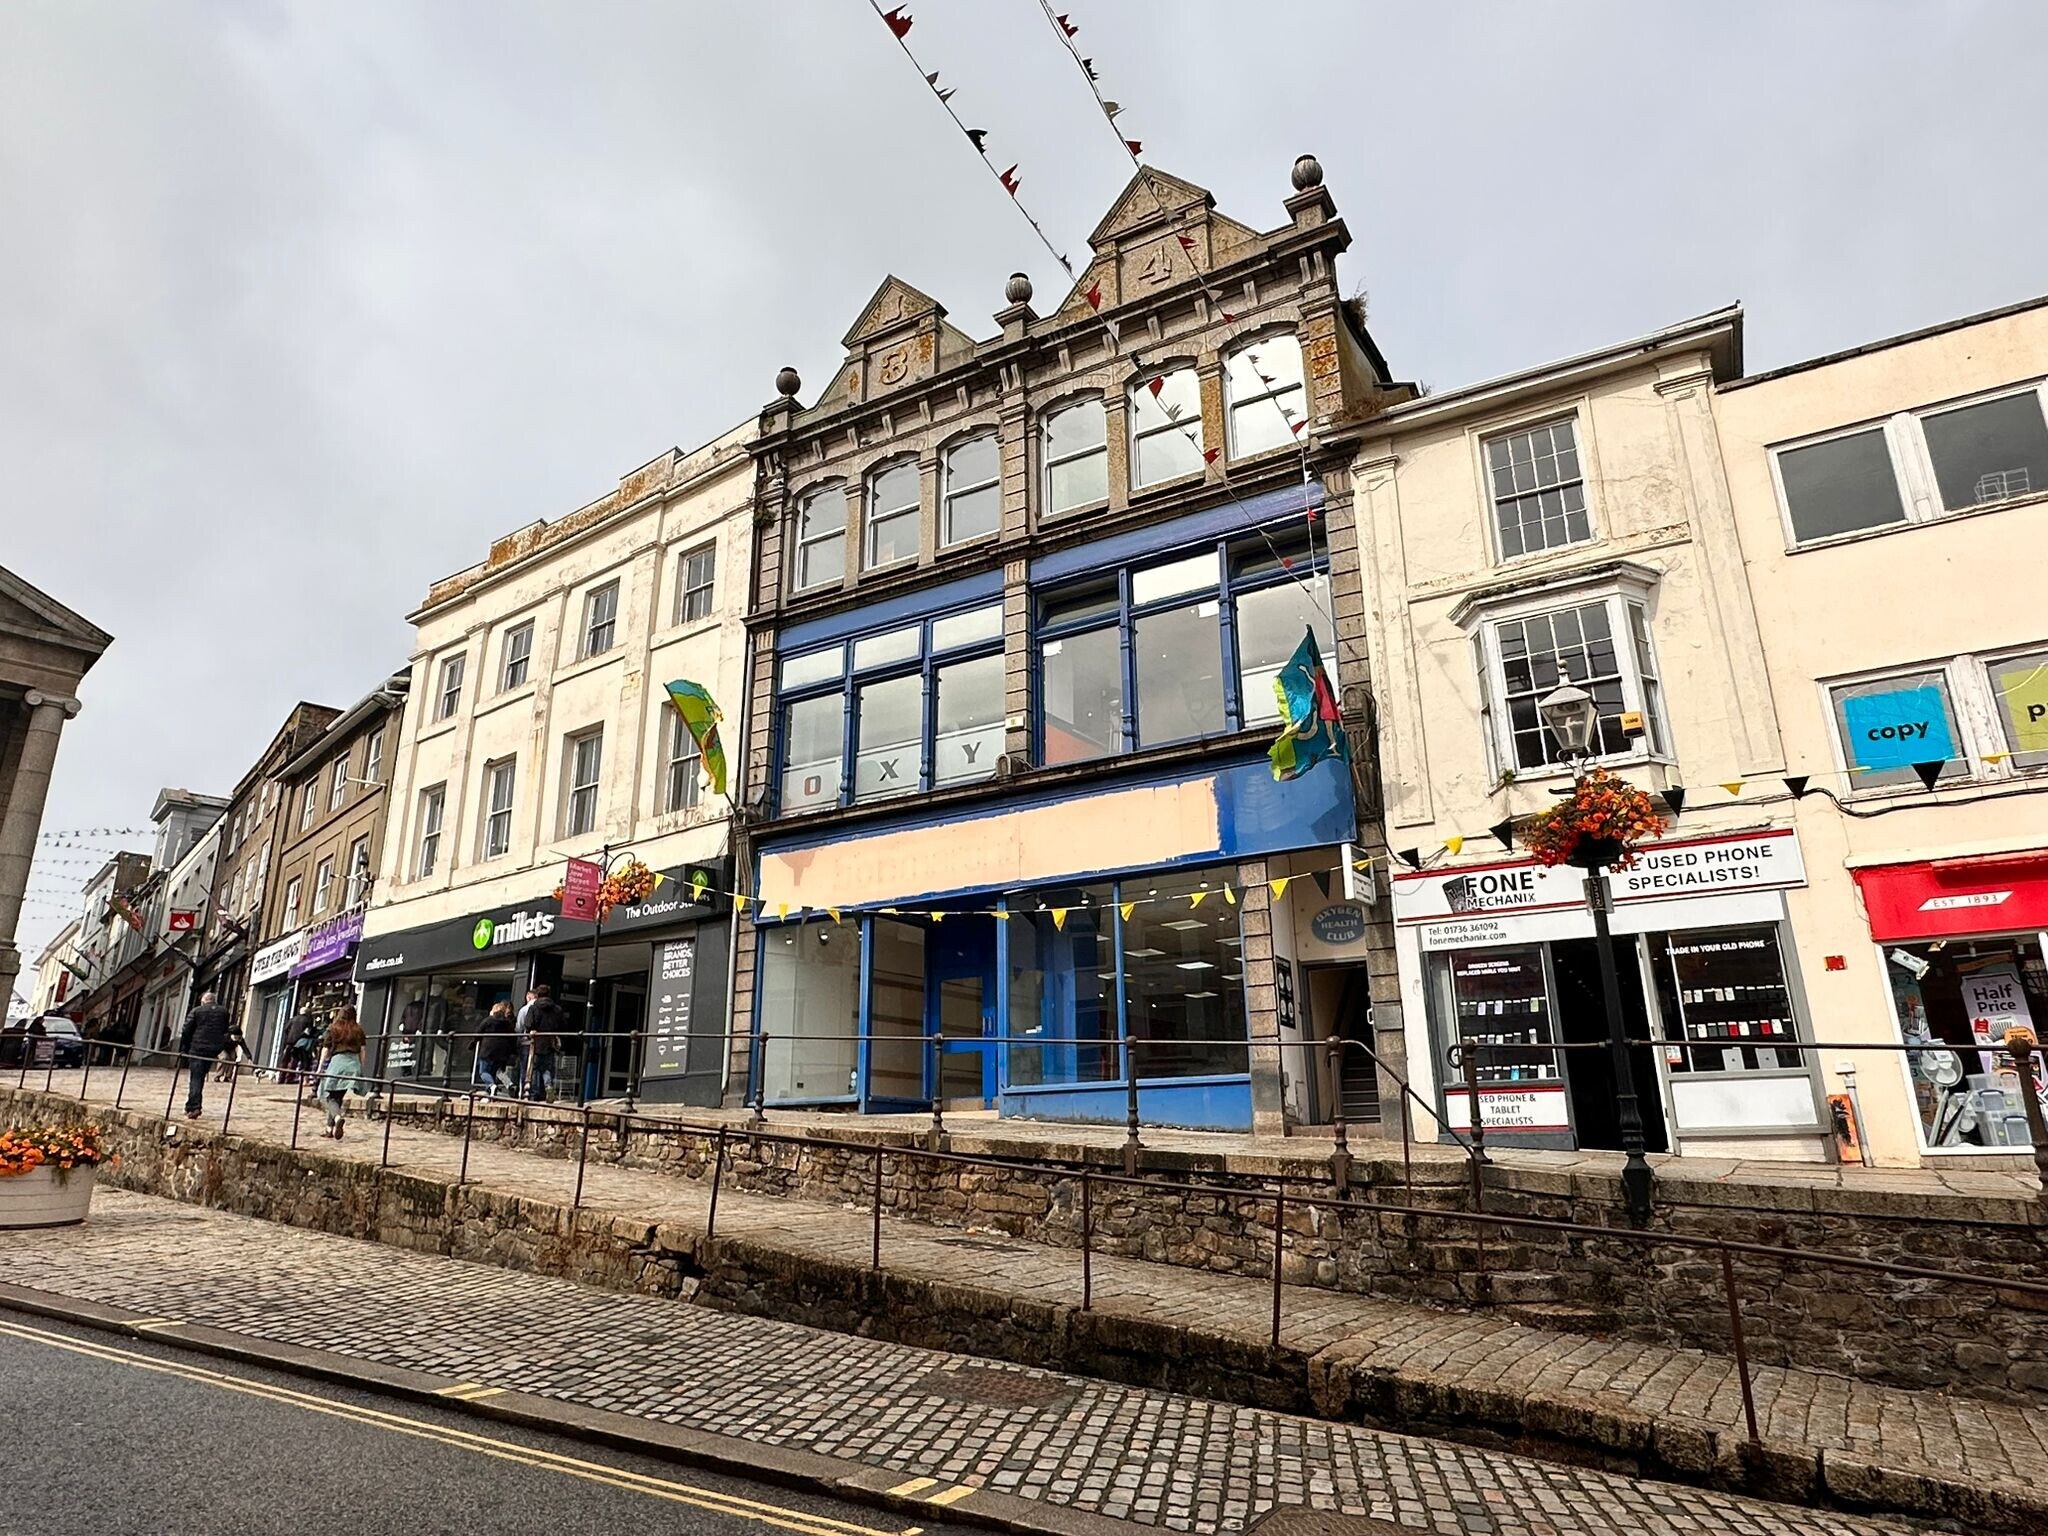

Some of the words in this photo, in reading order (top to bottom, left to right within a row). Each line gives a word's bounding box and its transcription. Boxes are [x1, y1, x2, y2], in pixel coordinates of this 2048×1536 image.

[2026, 702, 2048, 723] p
[1867, 719, 1930, 742] copy
[1647, 852, 1698, 870] USED
[1704, 844, 1774, 864] PHONE
[569, 862, 592, 874] Market
[1465, 871, 1534, 898] FONE
[1628, 865, 1760, 891] SPECIALISTS!
[1466, 892, 1536, 909] MECHANIX
[1967, 894, 1998, 905] 1893
[625, 905, 641, 920] The
[642, 899, 678, 916] Outdoor
[1315, 906, 1362, 923] OXYGEN
[493, 911, 555, 945] millets
[1320, 919, 1358, 930] HEALTH
[1428, 926, 1442, 936] Tel:
[1443, 924, 1468, 935] 01736
[1470, 922, 1499, 932] 361092
[1326, 930, 1356, 942] CLUB
[1429, 931, 1507, 946] fonemechanix.com
[1665, 945, 1690, 956] TRADE
[1690, 945, 1699, 954] IN
[1699, 943, 1721, 953] YOUR
[1721, 941, 1738, 951] OLD
[1738, 939, 1765, 950] PHONE
[365, 953, 405, 970] millets.co.uk
[663, 950, 693, 962] BRANDS,
[662, 959, 688, 971] BETTER
[662, 968, 691, 981] CHOICES
[1972, 983, 2013, 1001] Half
[1977, 1000, 2017, 1013] Price
[1479, 1094, 1495, 1104] SED
[1497, 1094, 1527, 1103] PHONE
[1529, 1093, 1537, 1102] &
[1490, 1105, 1521, 1114] TABLET
[1481, 1116, 1534, 1126] SPECIALISTS
